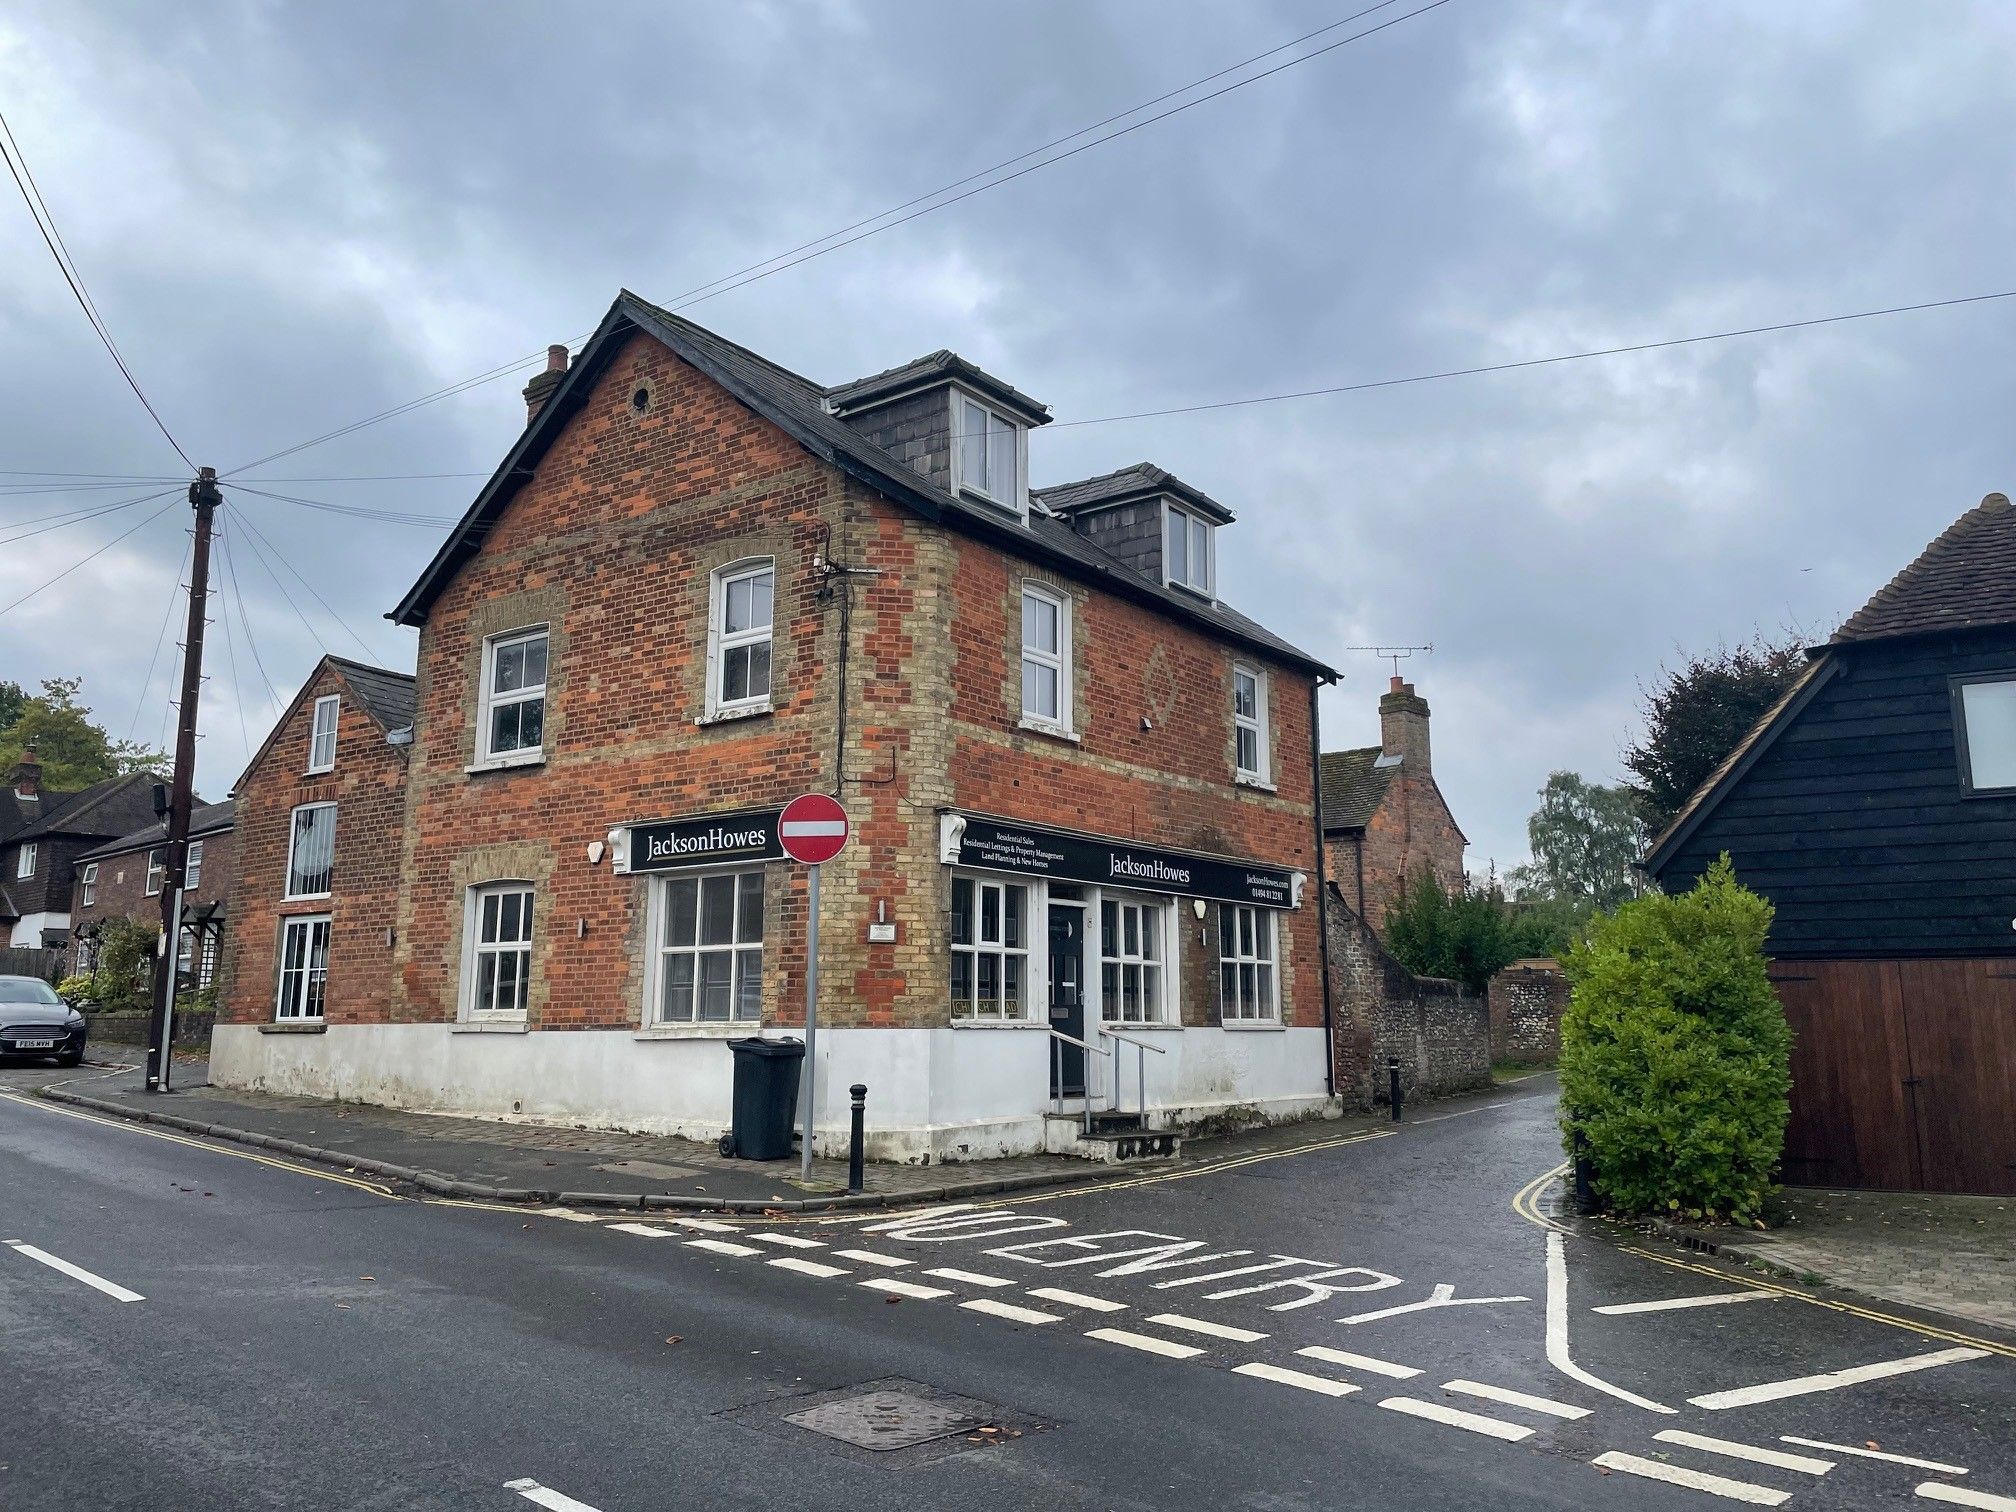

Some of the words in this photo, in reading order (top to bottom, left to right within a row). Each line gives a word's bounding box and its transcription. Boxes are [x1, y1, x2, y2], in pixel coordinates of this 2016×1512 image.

[646, 827, 766, 862] JacksonHowes
[963, 837, 991, 849] Residential
[991, 842, 1011, 854] Lettings
[1015, 846, 1036, 858] Property
[1036, 849, 1064, 861] Management
[996, 832, 1022, 844] Residential
[1022, 836, 1035, 846] Sales
[981, 851, 995, 861] Land
[995, 853, 1017, 866] Planning
[1021, 857, 1032, 866] New
[1032, 859, 1049, 869] Homes
[1109, 853, 1190, 883] JacksonHowes
[1246, 873, 1289, 889] JacksonHowes.com
[955, 1001, 989, 1012] CHCH
[858, 1204, 1069, 1242] NO
[982, 1230, 1532, 1326] ENTRY
